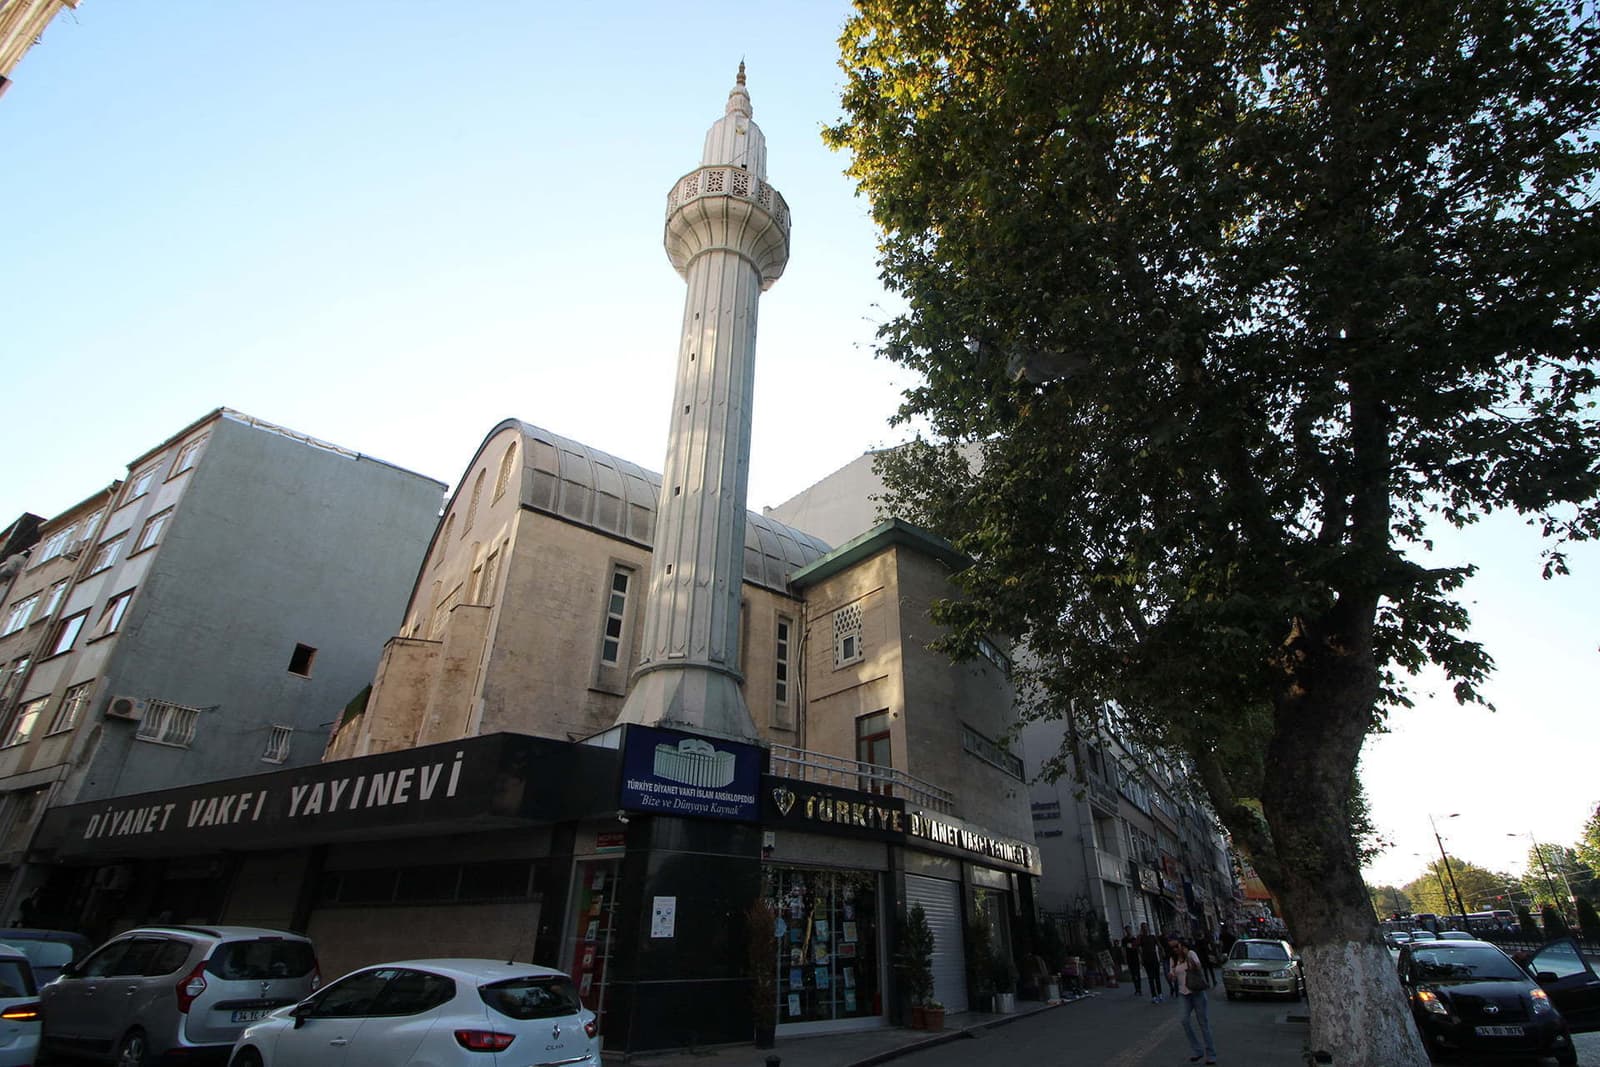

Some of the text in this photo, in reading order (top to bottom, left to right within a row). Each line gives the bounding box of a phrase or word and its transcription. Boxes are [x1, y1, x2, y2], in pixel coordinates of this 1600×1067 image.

[84, 751, 464, 839] DİYANET VAKFI YAYINEVİ
[627, 779, 755, 804] TÜRKİYE DİYANET VAKFI İSLAM ANSİKLOPEDİSİ
[662, 799, 673, 808] ve
[673, 798, 709, 813] Dünyaya
[804, 791, 904, 833] TÜRKİYE
[911, 811, 959, 847] DİYANET
[960, 829, 988, 854] VAKFI
